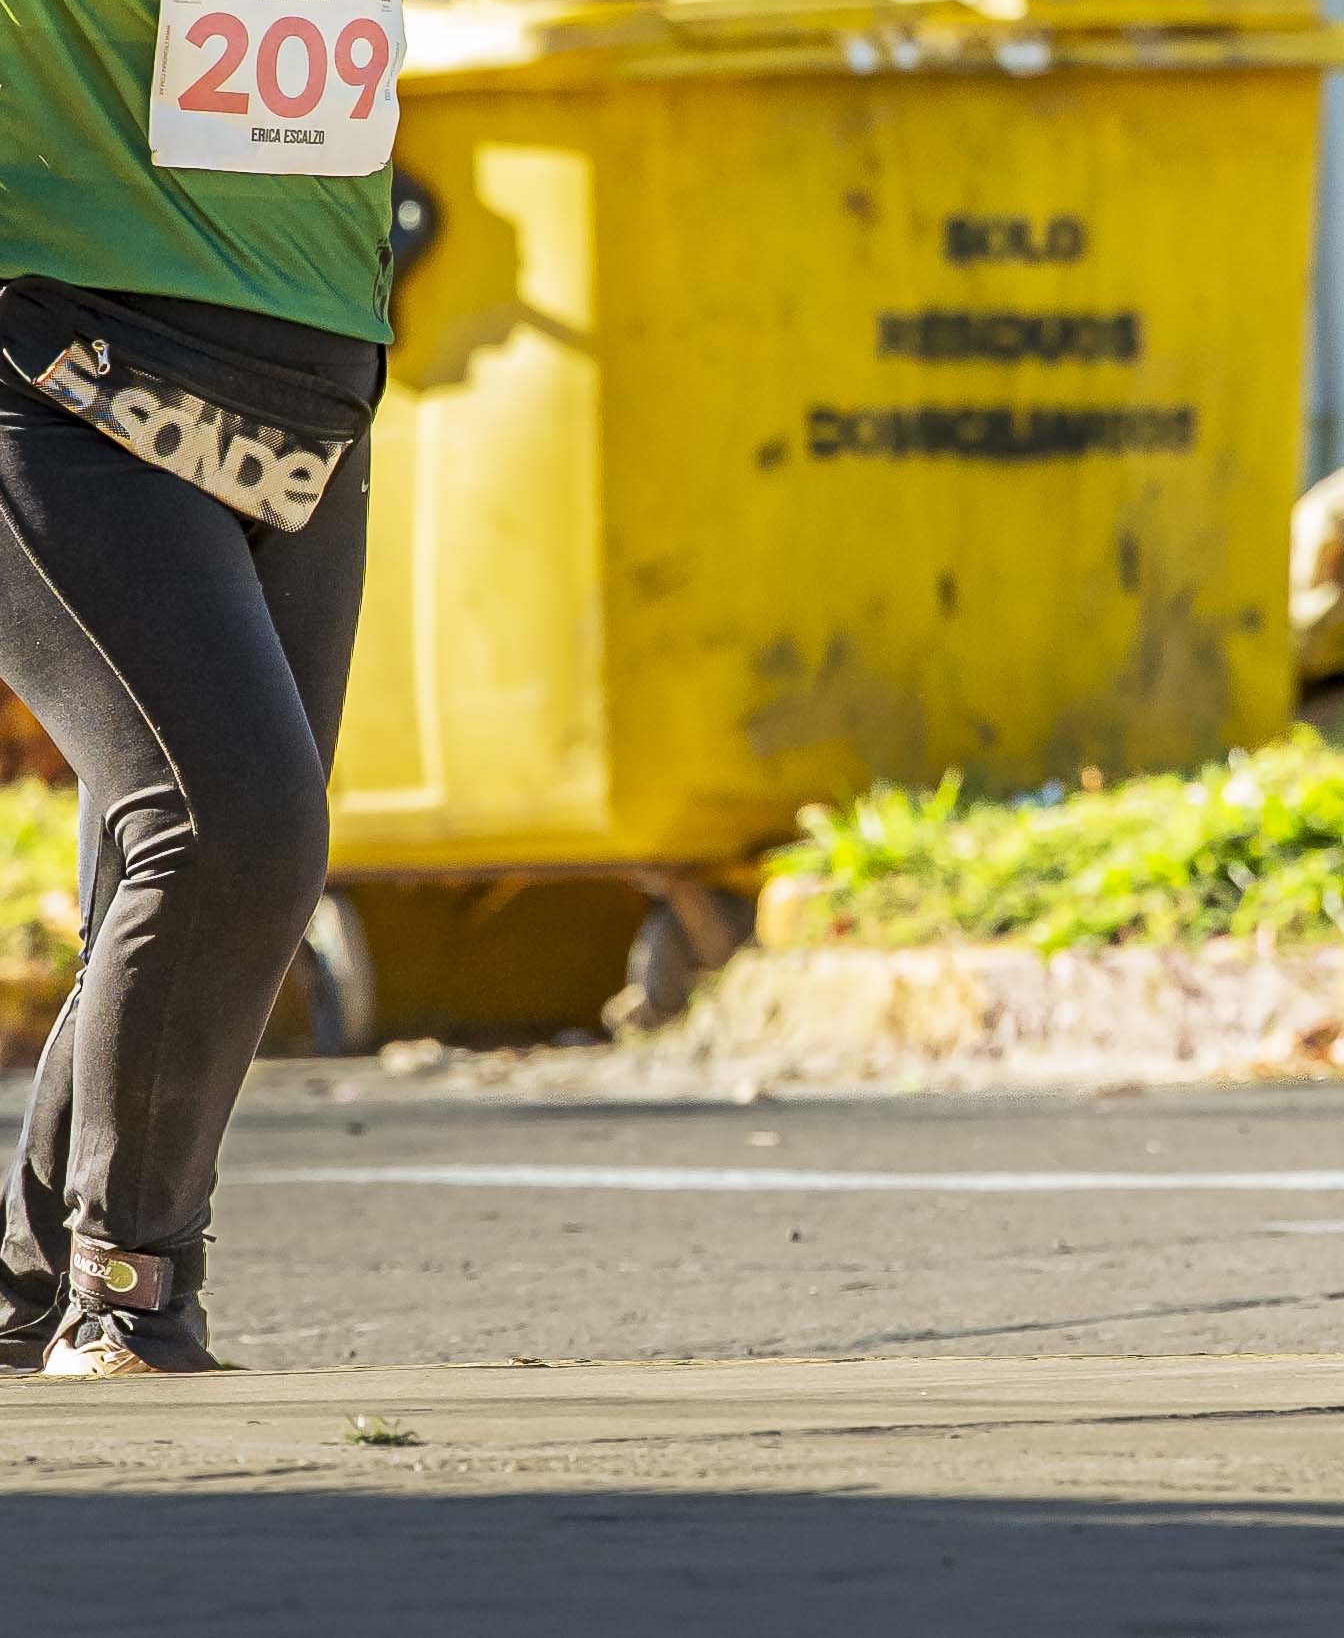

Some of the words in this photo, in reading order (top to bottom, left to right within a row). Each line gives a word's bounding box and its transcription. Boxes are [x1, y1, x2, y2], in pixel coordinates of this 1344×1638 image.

[177, 12, 389, 119] 209
[251, 127, 281, 143] ERICA
[284, 129, 325, 145] ESCALZO
